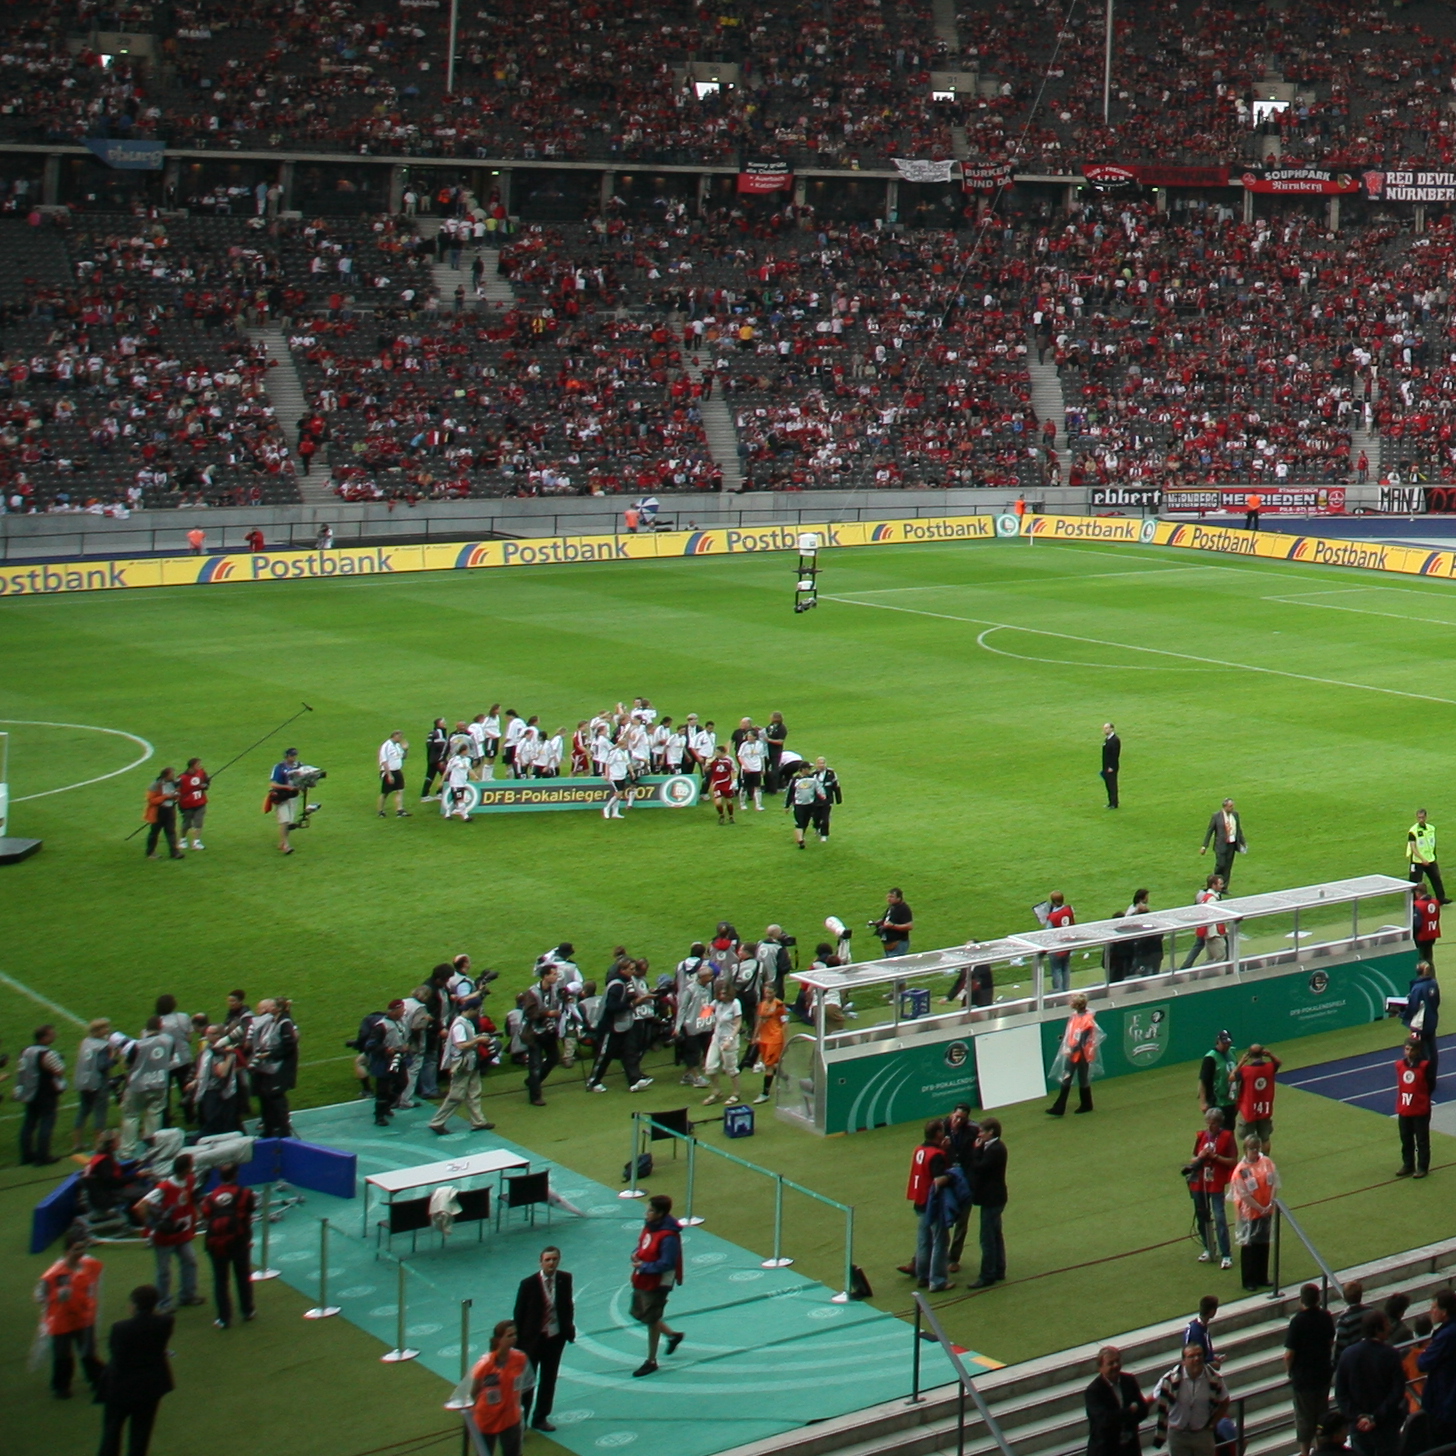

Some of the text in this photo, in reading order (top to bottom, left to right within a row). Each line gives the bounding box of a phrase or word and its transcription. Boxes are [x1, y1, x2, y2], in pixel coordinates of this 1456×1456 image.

[966, 175, 1012, 188] SIND DA
[1386, 171, 1414, 185] RED
[726, 524, 841, 553] Postbnk
[902, 515, 992, 540] Postbank
[1053, 517, 1136, 543] Postbank
[502, 538, 629, 566] Postbank
[1191, 526, 1259, 556] Postbank
[251, 547, 393, 580] Postbank
[1313, 540, 1389, 571] Postbank
[483, 787, 610, 804] DFB-Pokalsieger
[1401, 1093, 1413, 1106] TV
